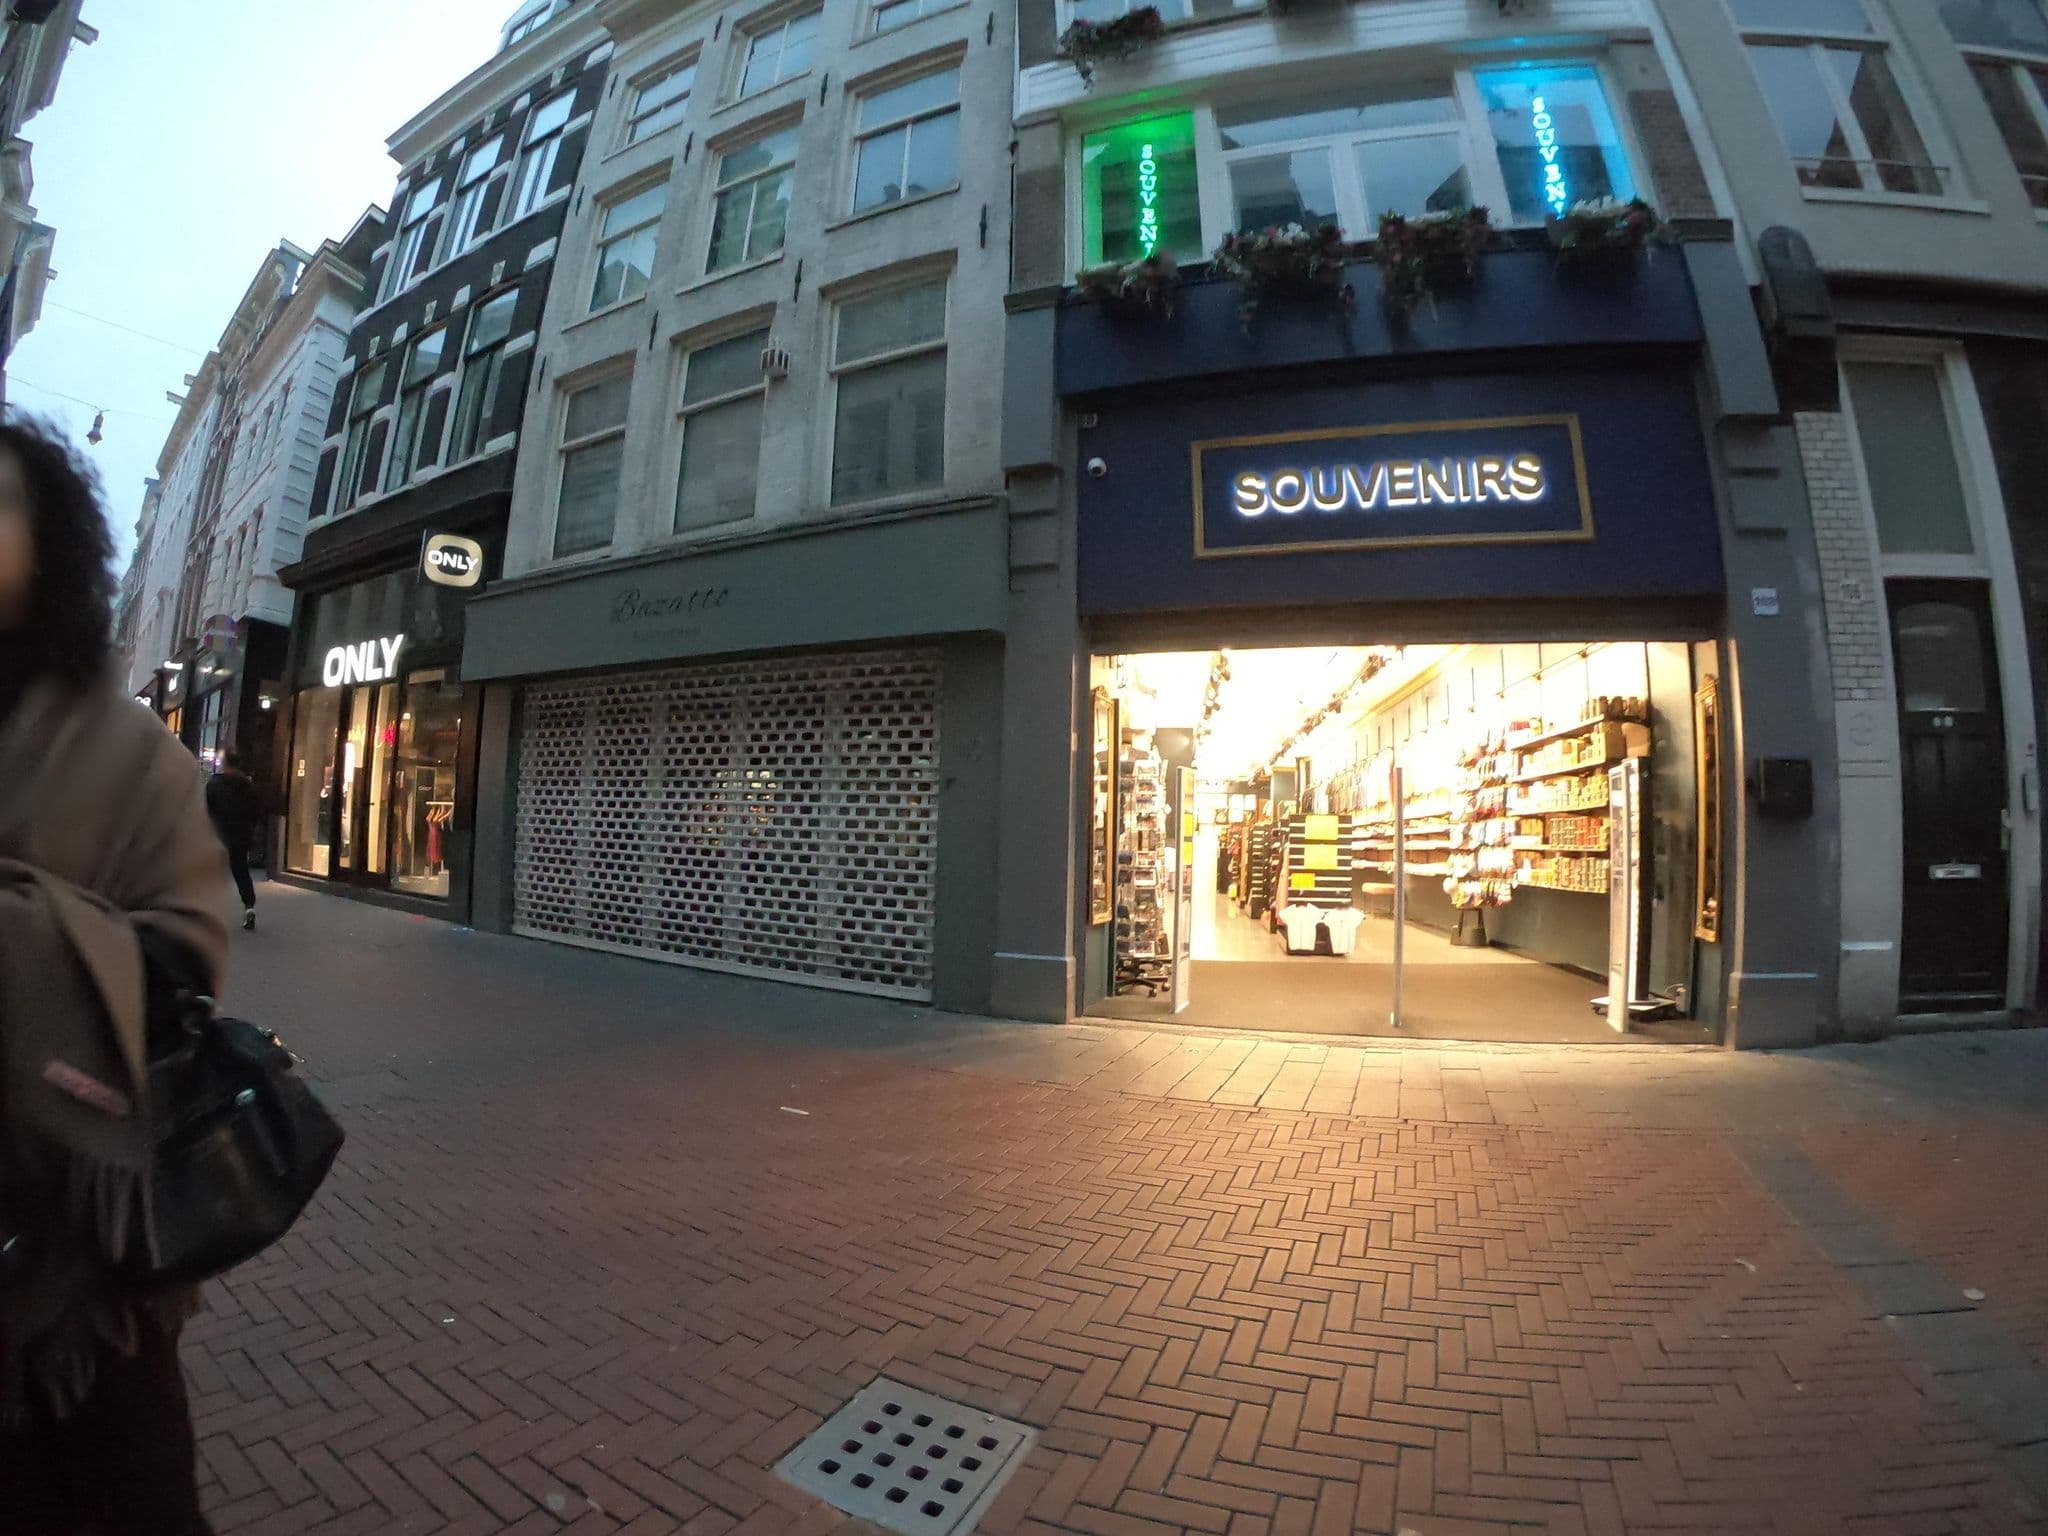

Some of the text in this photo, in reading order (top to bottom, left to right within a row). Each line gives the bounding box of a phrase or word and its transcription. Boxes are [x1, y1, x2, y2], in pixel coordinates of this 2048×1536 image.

[1234, 454, 1546, 516] SOUVENIRS
[427, 549, 479, 571] ONLY
[323, 633, 404, 688] ONLY
